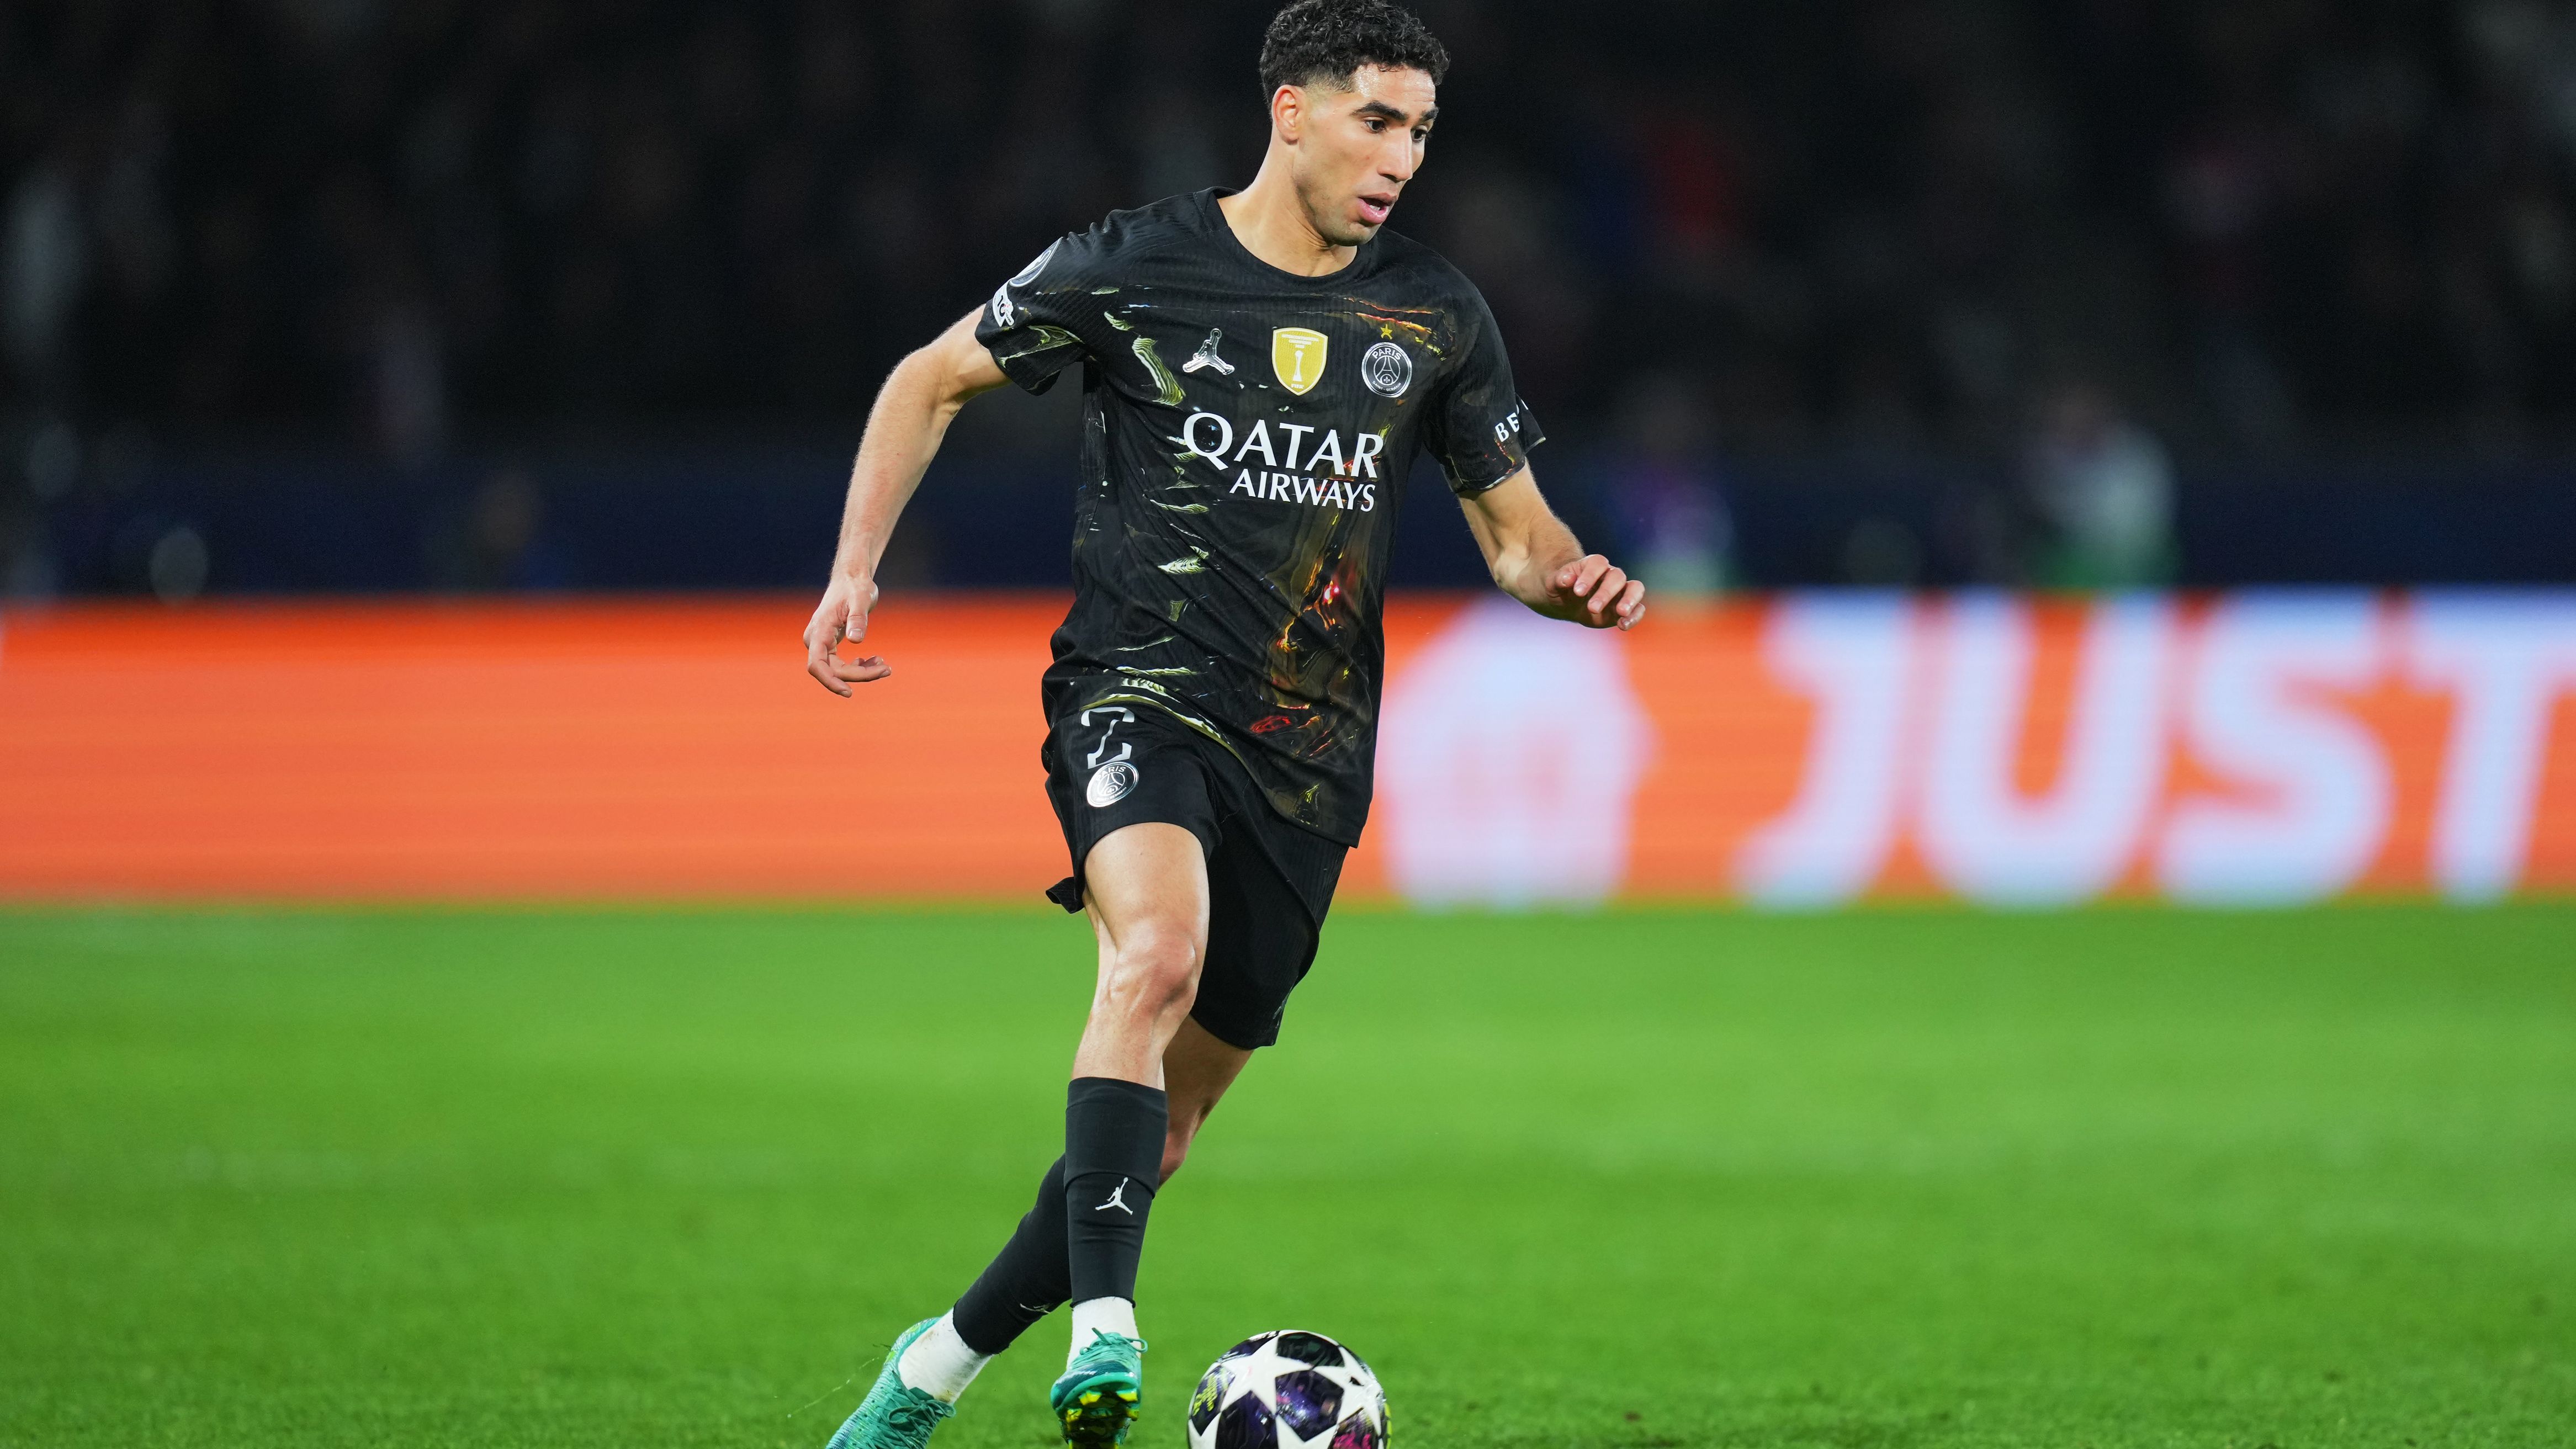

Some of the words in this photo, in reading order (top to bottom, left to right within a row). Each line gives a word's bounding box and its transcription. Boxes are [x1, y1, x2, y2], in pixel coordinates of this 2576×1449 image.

[1372, 347, 1402, 360] PARIS
[1184, 412, 1383, 478] QATAR
[1229, 469, 1375, 512] AIRWAYS
[1081, 707, 1135, 769] 2
[1734, 592, 2576, 908] JUST
[1095, 766, 1126, 781] PARIS
